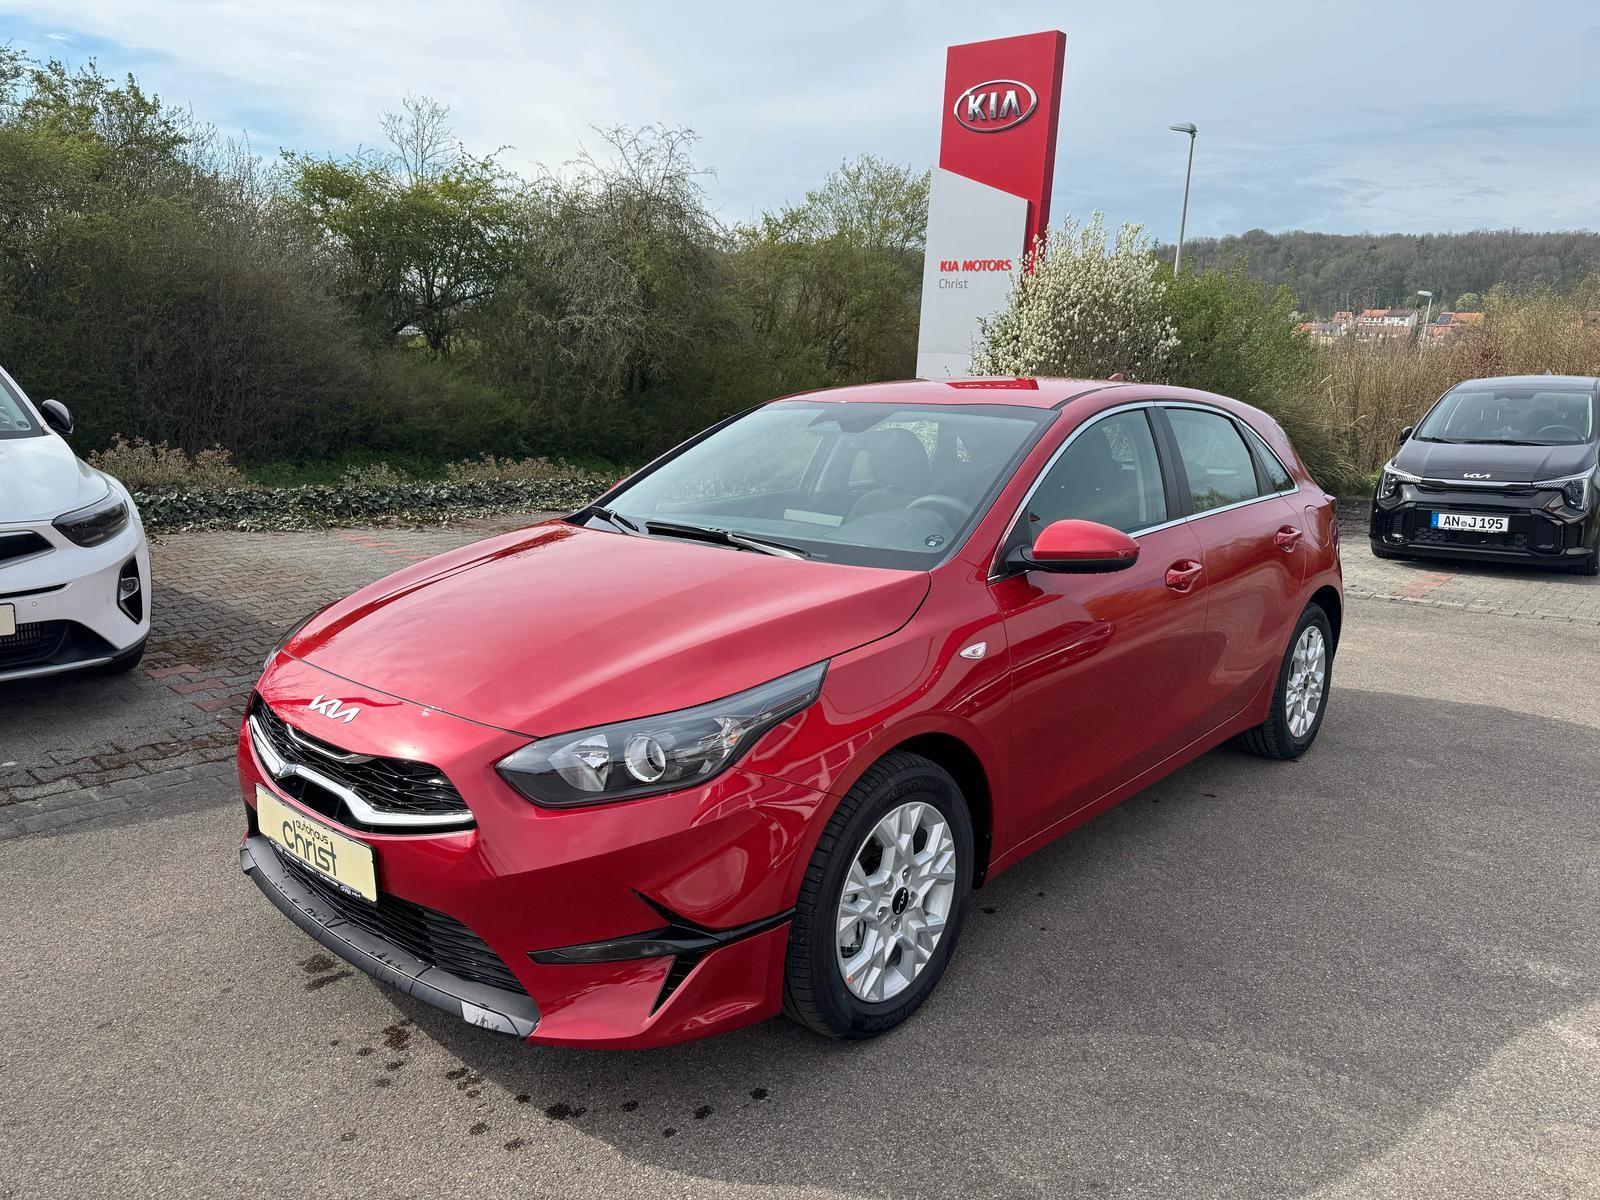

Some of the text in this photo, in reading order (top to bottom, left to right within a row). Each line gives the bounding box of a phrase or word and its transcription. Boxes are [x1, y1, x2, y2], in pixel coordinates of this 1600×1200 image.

[967, 90, 1020, 121] KIA
[940, 259, 1012, 272] KIA MOTORS
[938, 278, 969, 289] Christ
[1444, 516, 1460, 527] AN
